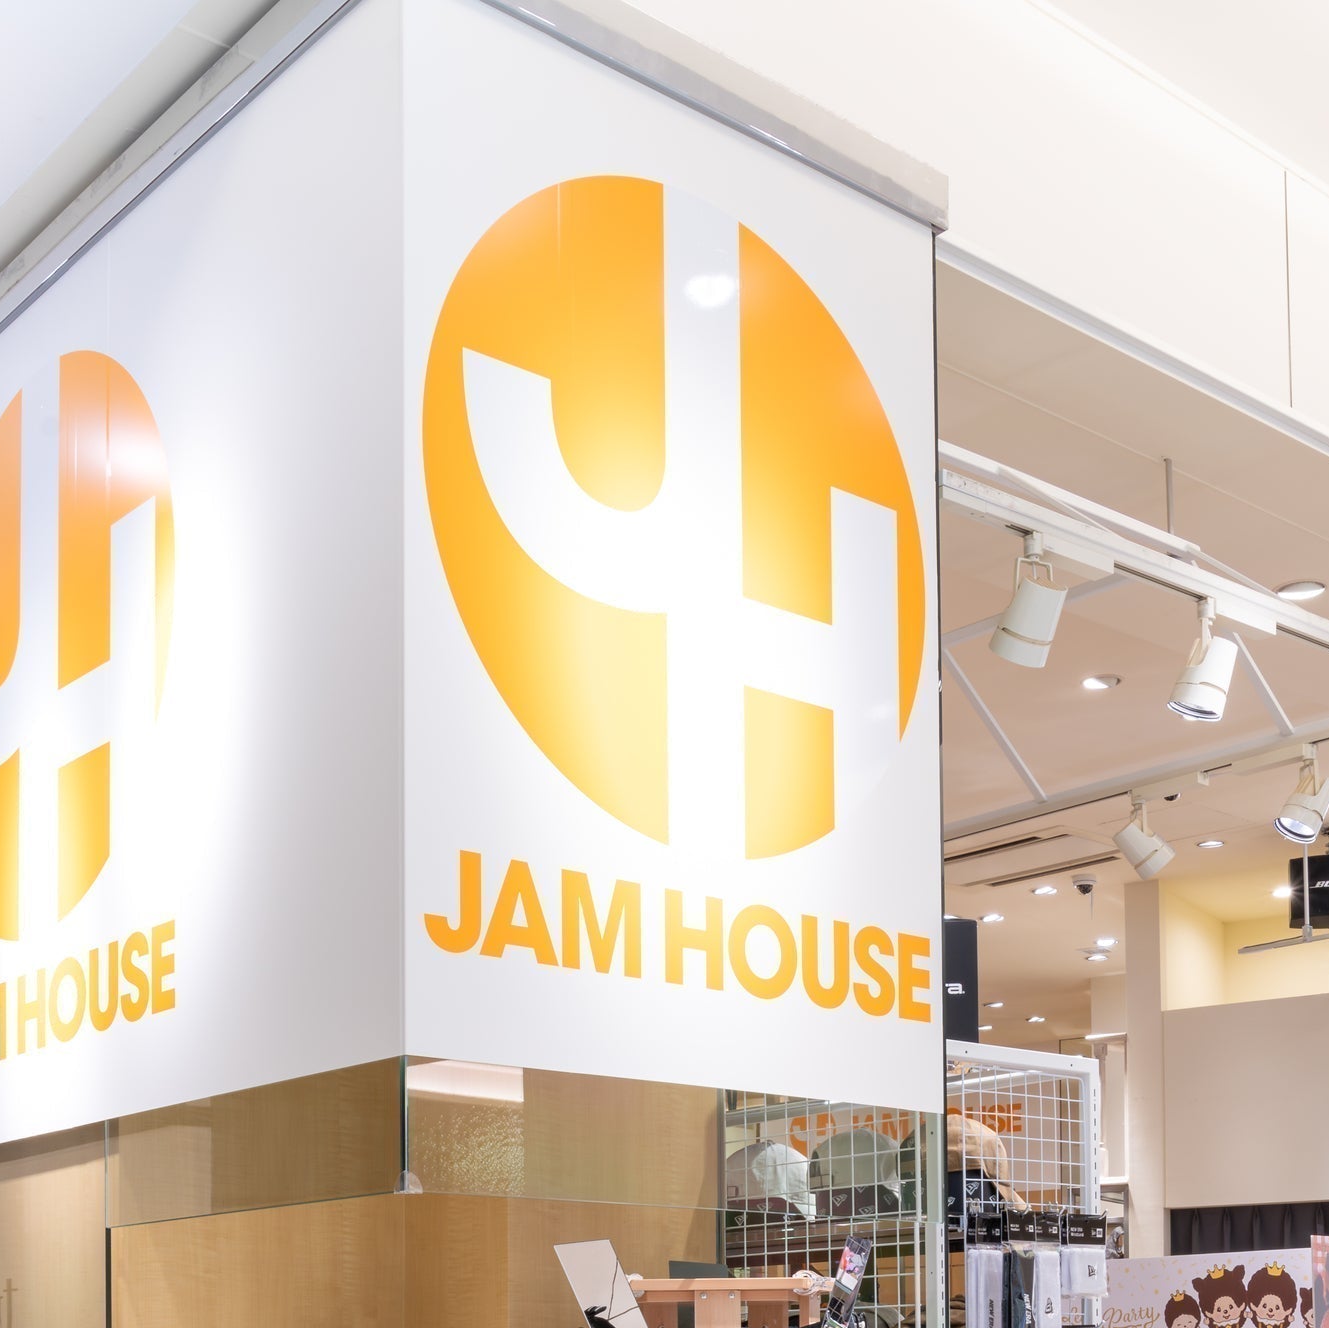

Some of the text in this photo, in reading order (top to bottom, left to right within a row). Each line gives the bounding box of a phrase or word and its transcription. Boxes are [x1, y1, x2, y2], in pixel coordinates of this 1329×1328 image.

[16, 919, 175, 1056] HOUSE
[423, 848, 931, 1024] JAM HOUSE
[1024, 1293, 1032, 1312] NEW
